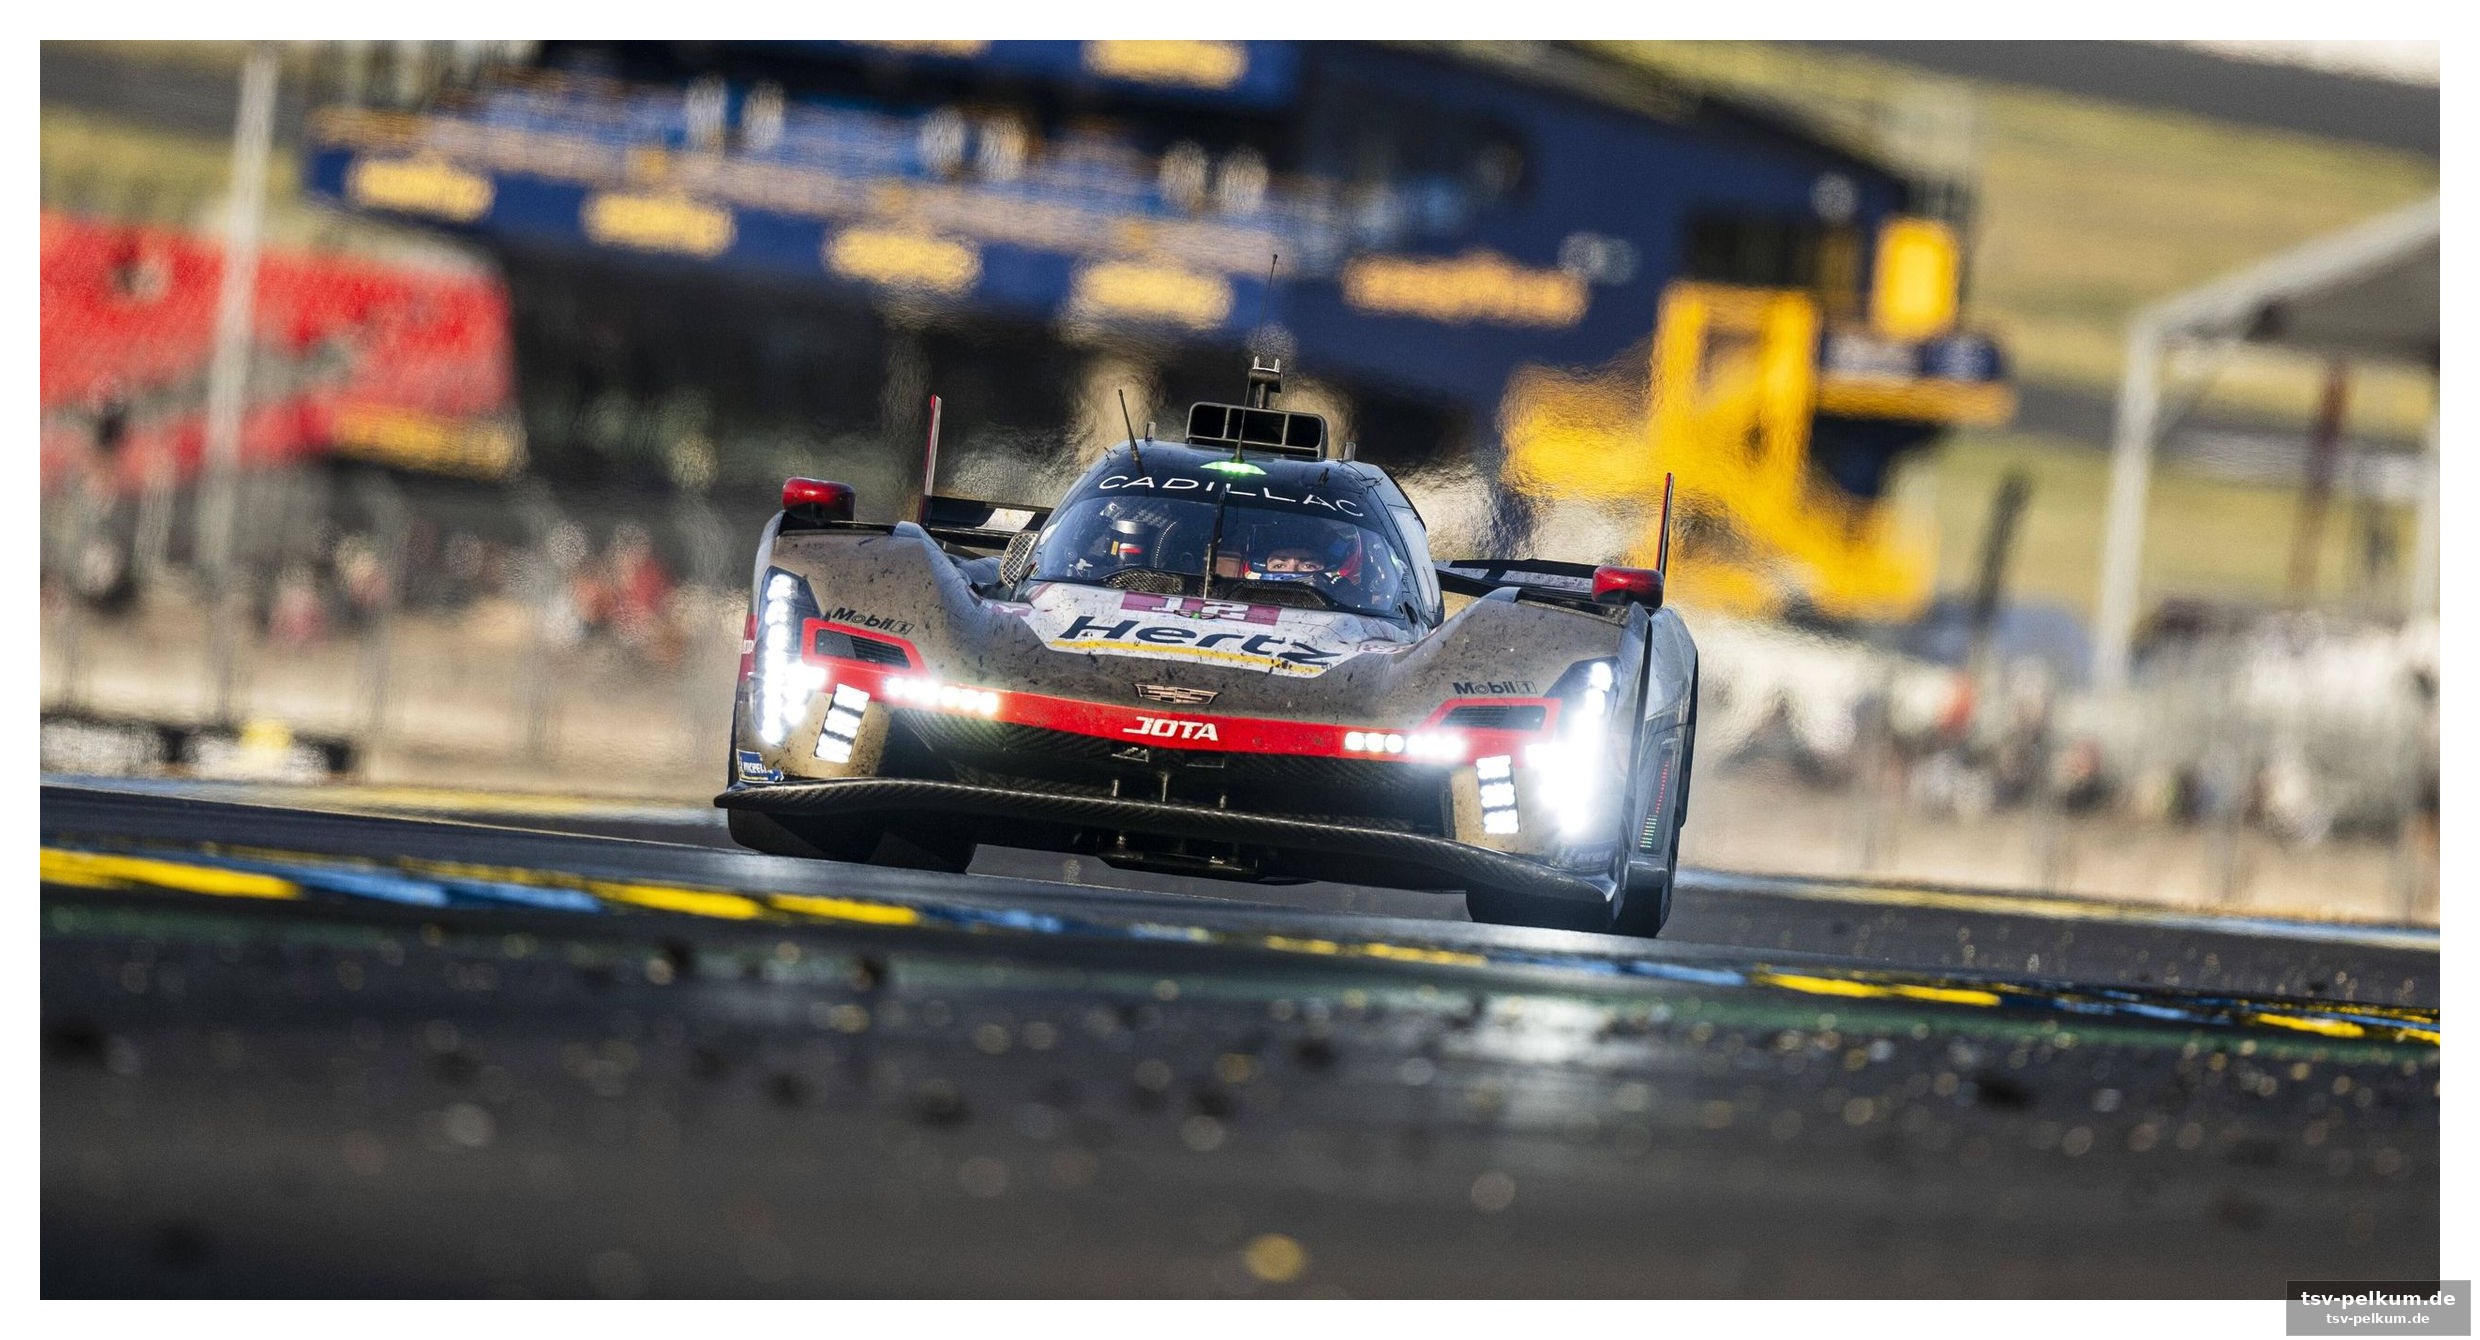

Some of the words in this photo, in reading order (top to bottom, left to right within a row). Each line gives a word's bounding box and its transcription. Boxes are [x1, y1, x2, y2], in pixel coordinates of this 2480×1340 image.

[1099, 475, 1365, 518] CADILLAC
[831, 607, 895, 630] Mobil
[1059, 615, 1342, 666] Hertz
[1453, 681, 1517, 695] Mobil
[1122, 716, 1219, 741] JOTA
